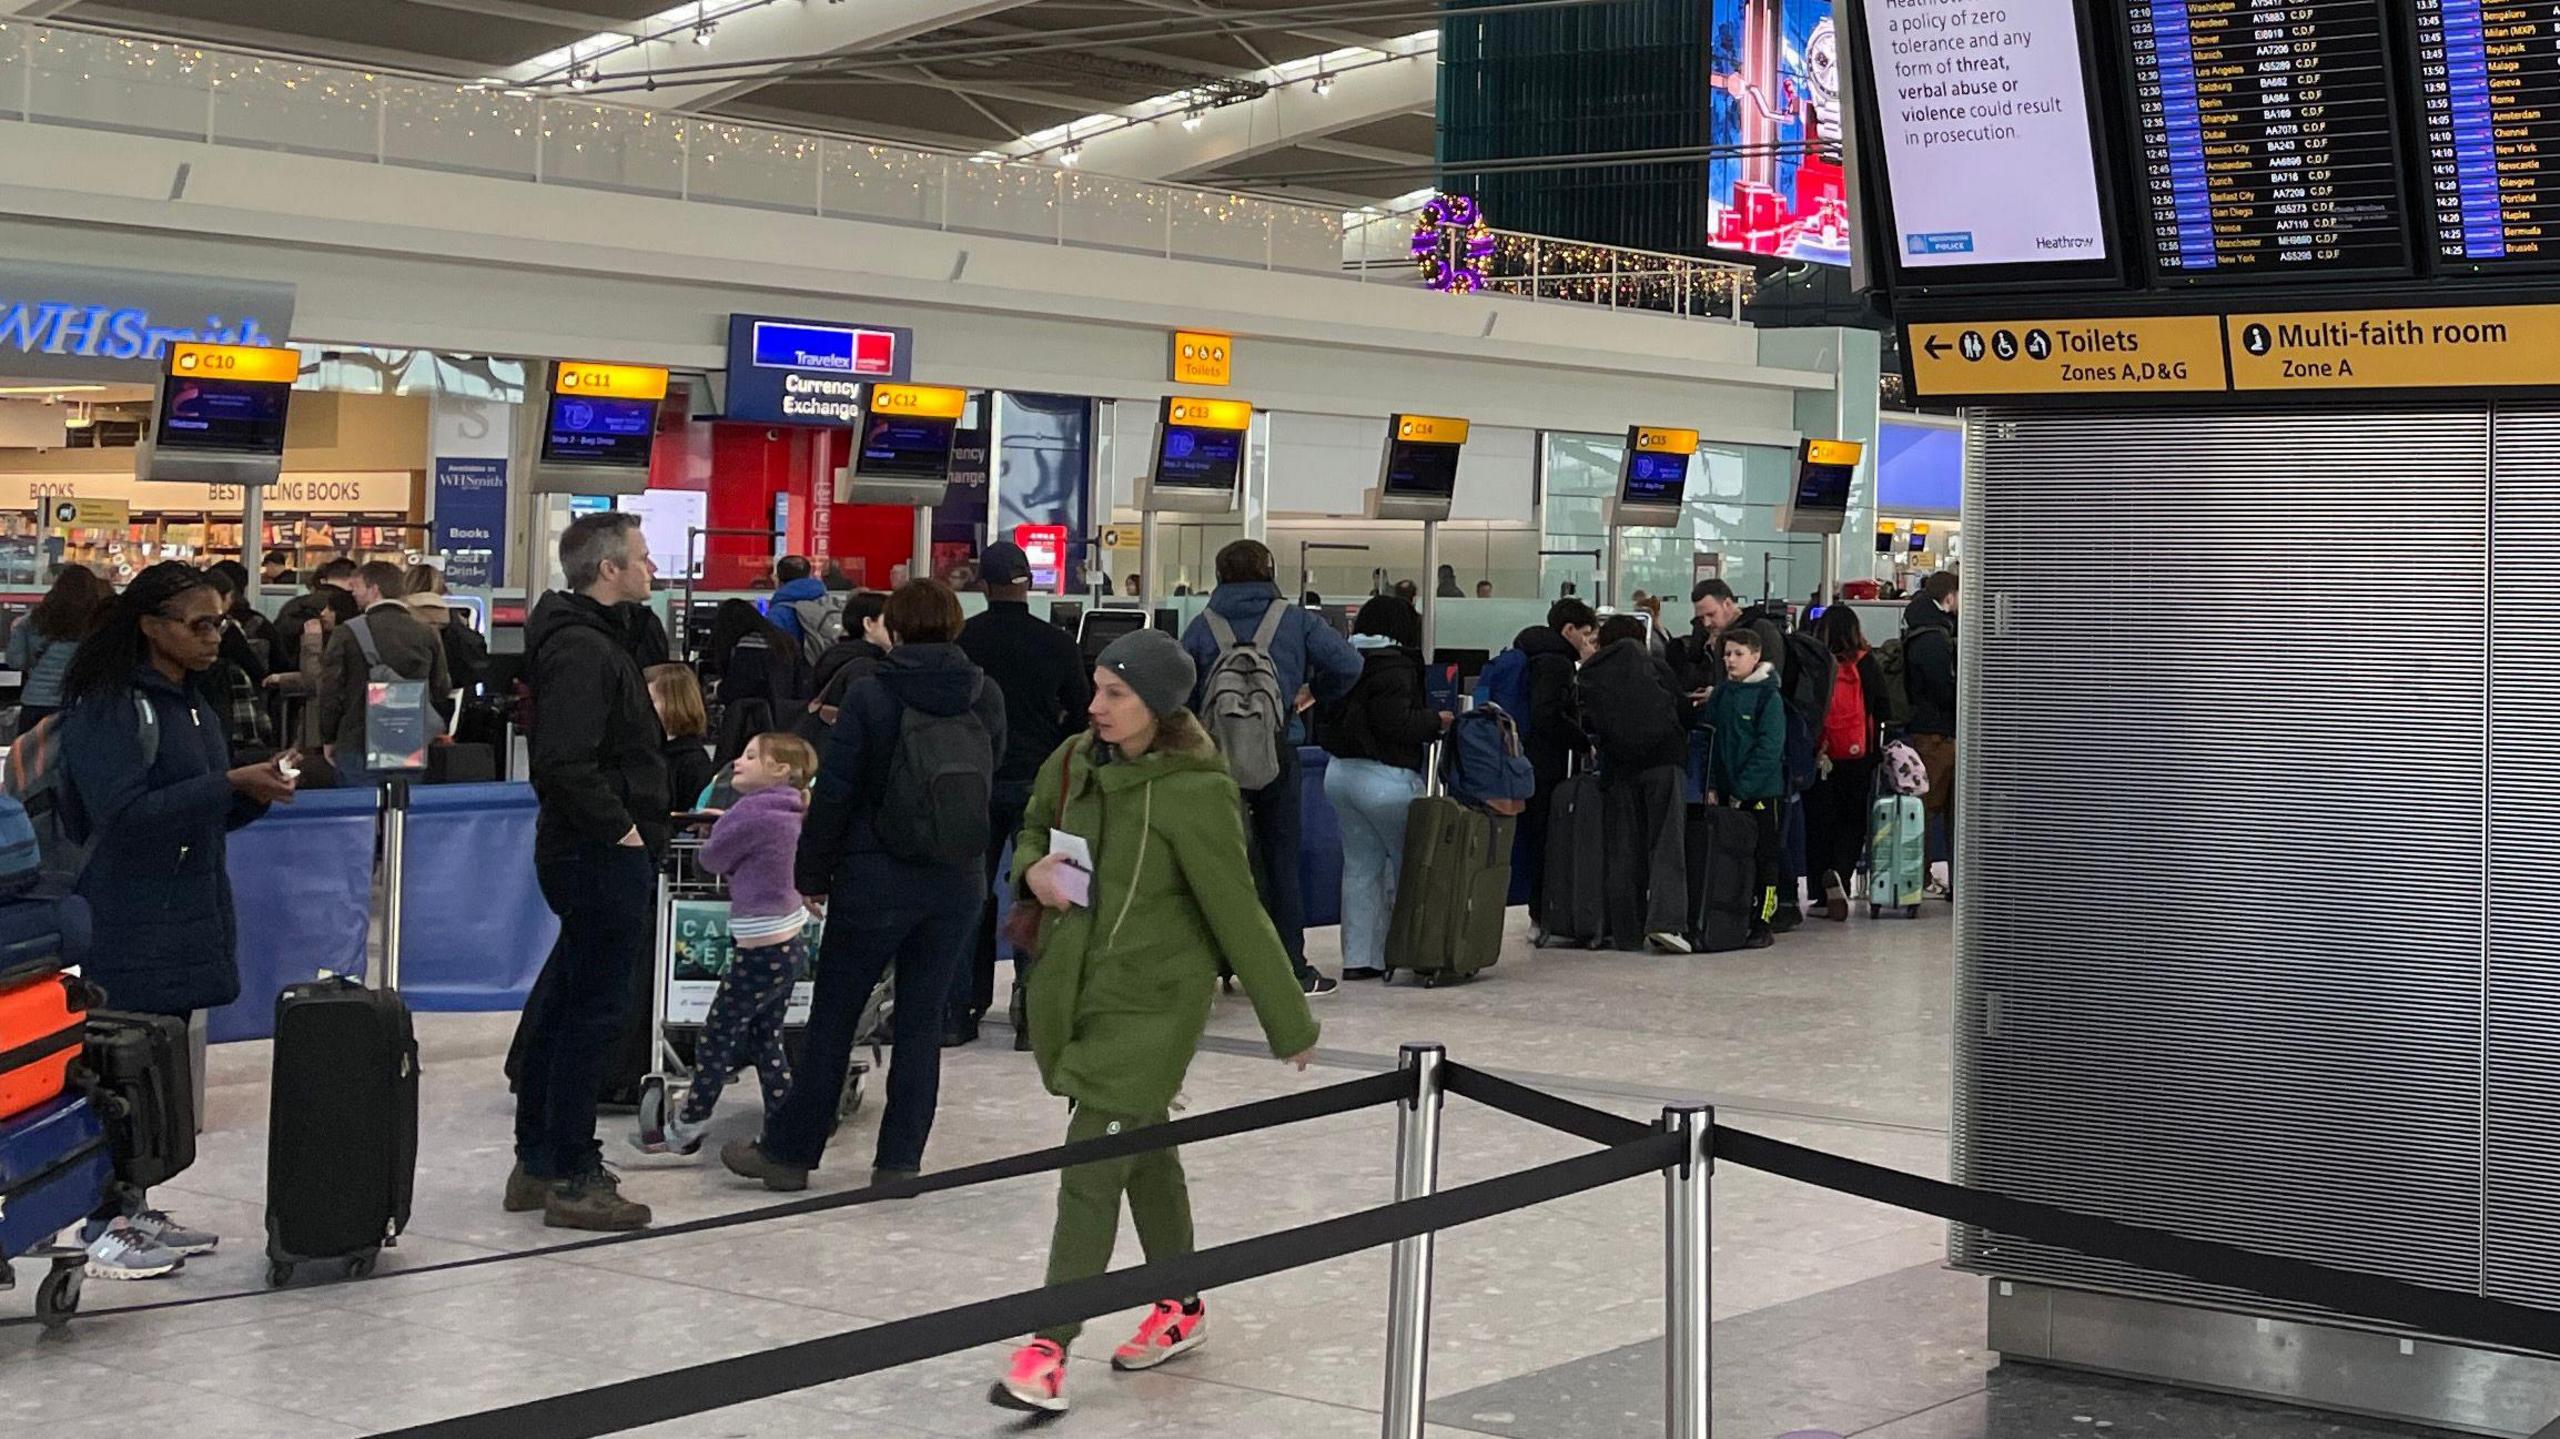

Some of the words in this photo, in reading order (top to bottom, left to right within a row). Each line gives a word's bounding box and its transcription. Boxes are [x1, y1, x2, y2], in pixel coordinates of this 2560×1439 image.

[1889, 19, 1898, 32] a
[1902, 13, 1946, 34] policy
[1951, 9, 1966, 26] of
[1972, 8, 2006, 24] zero
[1892, 37, 1965, 55] tolerance
[1969, 31, 1998, 48] and
[2003, 30, 2032, 48] any
[1895, 61, 1932, 77] form
[1937, 58, 1952, 74] of
[1956, 55, 2010, 72] threat,
[2196, 68, 2211, 77] Los
[2423, 66, 2445, 76] 13:50
[1898, 81, 1947, 100] verbal
[1952, 78, 1998, 97] abuse
[2002, 79, 2019, 93] or
[2489, 79, 2521, 88] Geneva
[1902, 102, 1966, 123] violence
[1970, 100, 2012, 119] could
[2017, 97, 2063, 116] result
[1905, 130, 1919, 146] in
[1924, 125, 2020, 148] prosecution.
[2430, 132, 2452, 142] 14:10
[2146, 148, 2168, 159] 12:45
[2233, 143, 2250, 155] City
[2431, 148, 2453, 158] 14:10
[2496, 146, 2515, 155] New
[2516, 143, 2538, 152] York
[2433, 165, 2455, 175] 14:10
[2152, 195, 2174, 206] 12:50
[2436, 197, 2459, 207] 14:20
[2212, 208, 2229, 218] San
[2438, 213, 2460, 223] 14:20
[2440, 229, 2461, 239] 14:25
[2035, 236, 2094, 250] Heathrow
[2441, 245, 2463, 255] 14:25
[2057, 329, 2139, 353] Toilets
[2278, 320, 2423, 349] Multi-faith
[2432, 322, 2508, 345] room
[203, 355, 235, 370] C10
[795, 350, 850, 368] Travelex
[1185, 363, 1221, 376] Toilets
[2060, 362, 2118, 382] Zones
[2121, 360, 2188, 382] A,D&G
[2282, 359, 2332, 379] Zone
[2337, 358, 2353, 376] A
[583, 373, 611, 388] C11
[785, 374, 860, 399] Currency
[783, 396, 859, 420] Exchange
[893, 395, 917, 407] C12
[1189, 406, 1210, 418] C13
[1415, 424, 1433, 434] C14
[440, 474, 503, 488] WHSmith
[30, 483, 75, 500] BOOKS
[306, 482, 360, 500] BOOKS
[449, 527, 490, 539] Books
